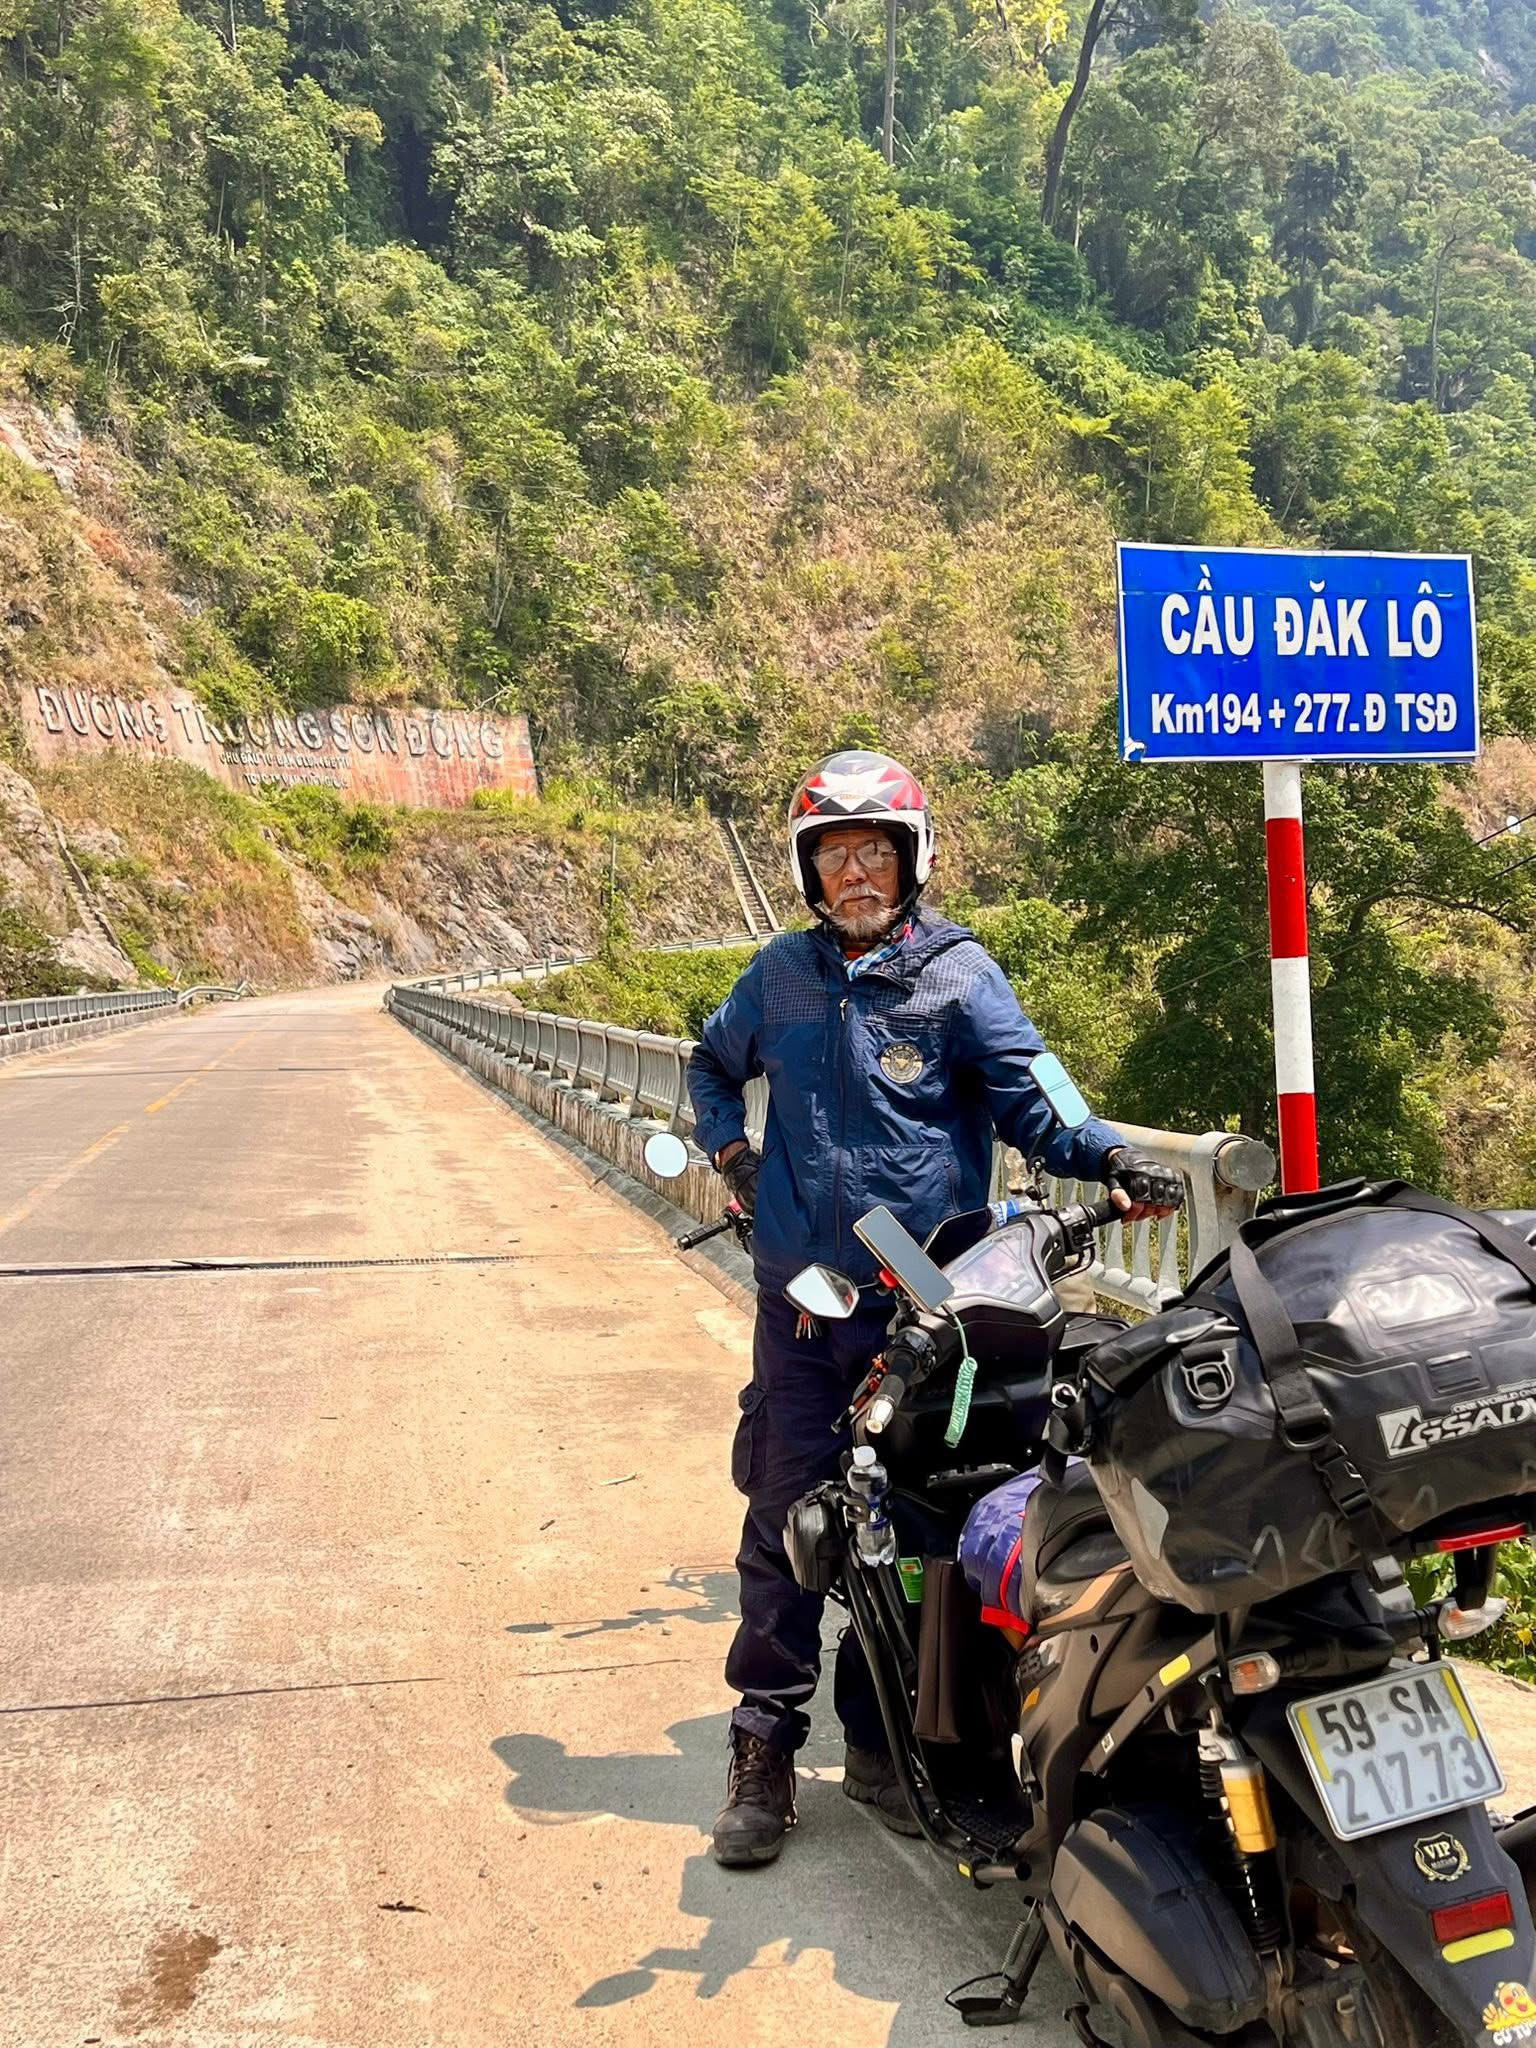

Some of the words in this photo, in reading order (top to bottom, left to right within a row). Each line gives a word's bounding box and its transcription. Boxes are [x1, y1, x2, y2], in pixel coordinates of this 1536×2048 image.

[1160, 563, 1255, 655] CẦU
[1273, 579, 1370, 657] ĐĂK
[1386, 581, 1443, 658] LÔ
[1151, 692, 1261, 734] Km194
[1395, 692, 1457, 733] TSĐ
[1332, 1735, 1487, 1826] 217.73
[1423, 1841, 1451, 1859] VIP
